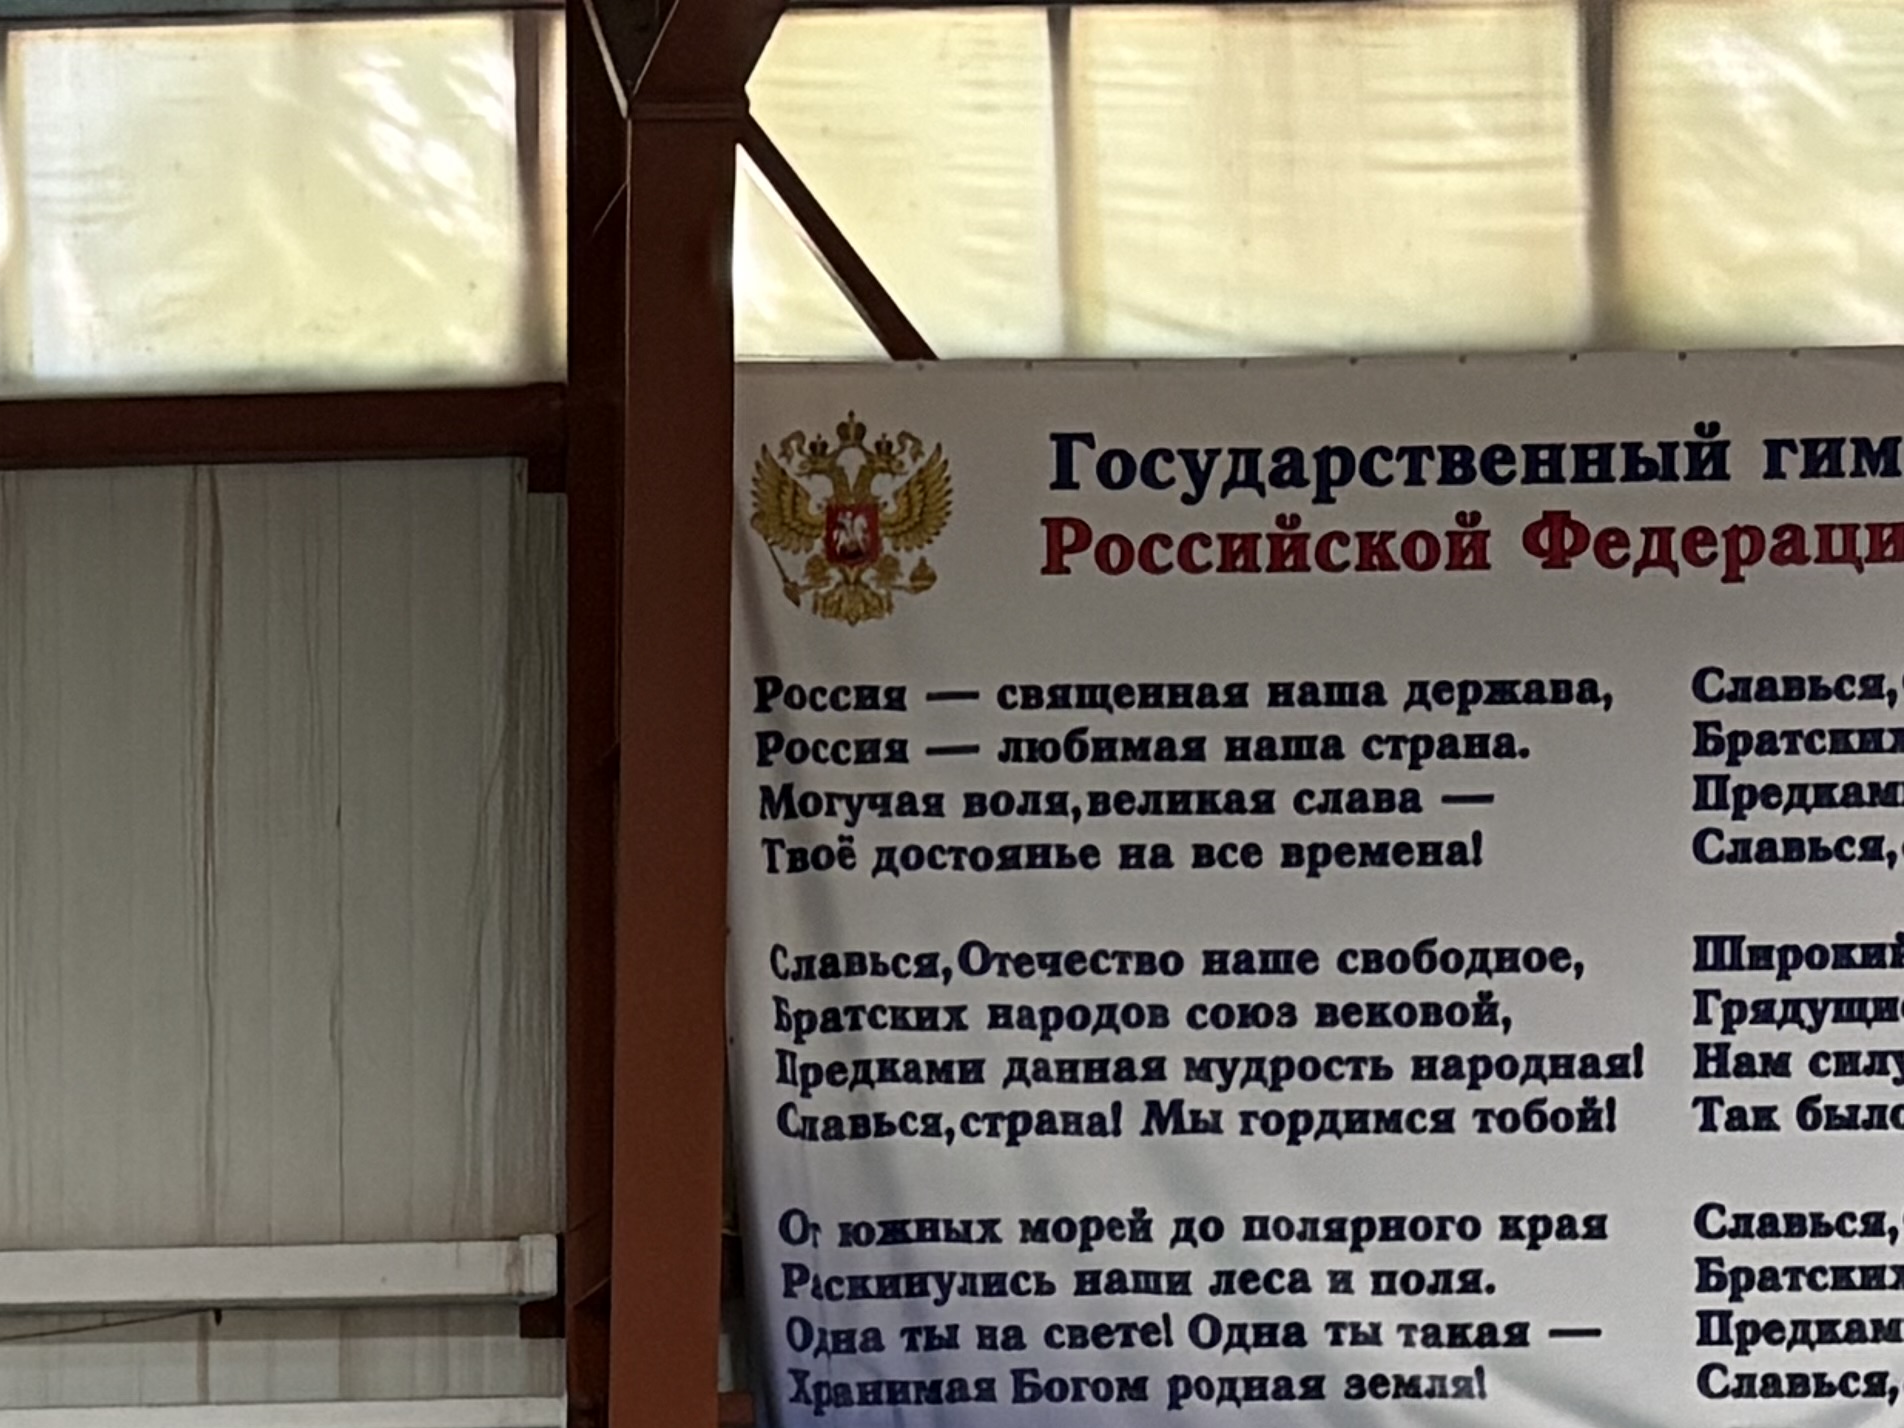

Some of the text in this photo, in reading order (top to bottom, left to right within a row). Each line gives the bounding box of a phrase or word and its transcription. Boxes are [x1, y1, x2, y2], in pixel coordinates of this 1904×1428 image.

[1049, 421, 1903, 506] Государственный гим
[1040, 510, 1904, 584] Российской Федераци
[753, 675, 907, 714] Россия
[997, 682, 1249, 715] священная
[1267, 681, 1388, 708] наша
[1403, 678, 1613, 716] держава,
[755, 730, 909, 767] Россия
[997, 726, 1207, 764] любимая
[1224, 734, 1346, 762] наша
[1362, 732, 1530, 771] страна.
[759, 781, 945, 828] Могучая
[1293, 788, 1423, 816] слава
[1692, 774, 1904, 821] Предкам
[761, 830, 1482, 879] Твоё достоянье на все времена!
[1202, 948, 1319, 976] наше
[1337, 937, 1584, 980] свободное,
[772, 990, 1512, 1045] Братских народов союз вековой,
[1693, 988, 1904, 1036] Грядущи
[775, 1042, 1644, 1099] Предками данная мудрость народная!
[1693, 1042, 1792, 1079] Нам
[1139, 1098, 1224, 1136] Мы
[1238, 1107, 1455, 1146] гордимся
[1472, 1096, 1616, 1134] тобой!
[1692, 1095, 1781, 1133] Так
[838, 1218, 1003, 1248] южных
[1019, 1207, 1153, 1253] морей
[1169, 1216, 1224, 1249] до
[1242, 1215, 1481, 1253] полярного
[1499, 1214, 1608, 1251] края
[1073, 1268, 1192, 1296] наши
[1209, 1268, 1312, 1296] леса
[1327, 1269, 1355, 1295] и
[1370, 1268, 1495, 1296] поля.
[786, 1316, 885, 1363] Одна
[900, 1324, 960, 1353] ты
[975, 1325, 1027, 1351] на
[1044, 1312, 1174, 1350] свете!
[1188, 1312, 1308, 1355] Одна
[1324, 1321, 1383, 1347] ты
[1397, 1322, 1530, 1349] такая
[787, 1365, 1487, 1417] Хранимая Богом родная земля!
